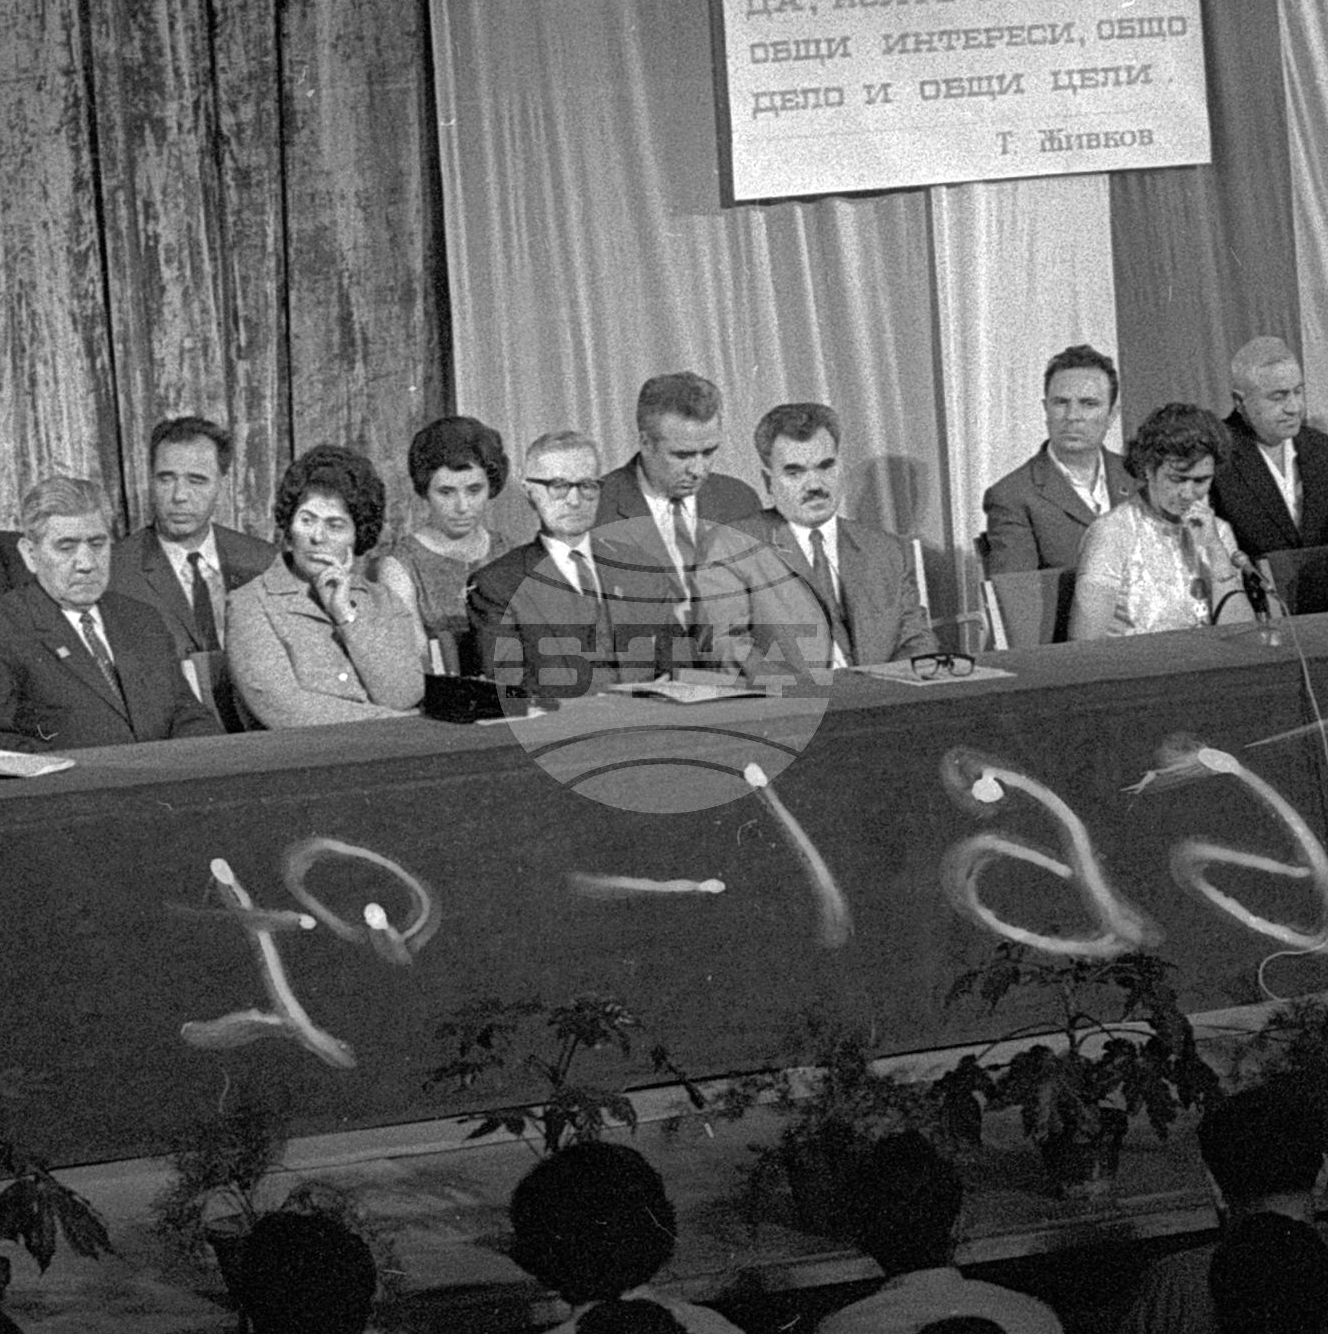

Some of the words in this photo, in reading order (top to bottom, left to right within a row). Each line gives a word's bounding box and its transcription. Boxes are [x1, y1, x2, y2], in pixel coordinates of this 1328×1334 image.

[749, 37, 852, 65] ОБЩИ
[1096, 16, 1188, 43] ОБЩО
[752, 88, 844, 119] ДЕЛО
[864, 82, 894, 107] И
[919, 74, 1025, 103] ОБЩИ
